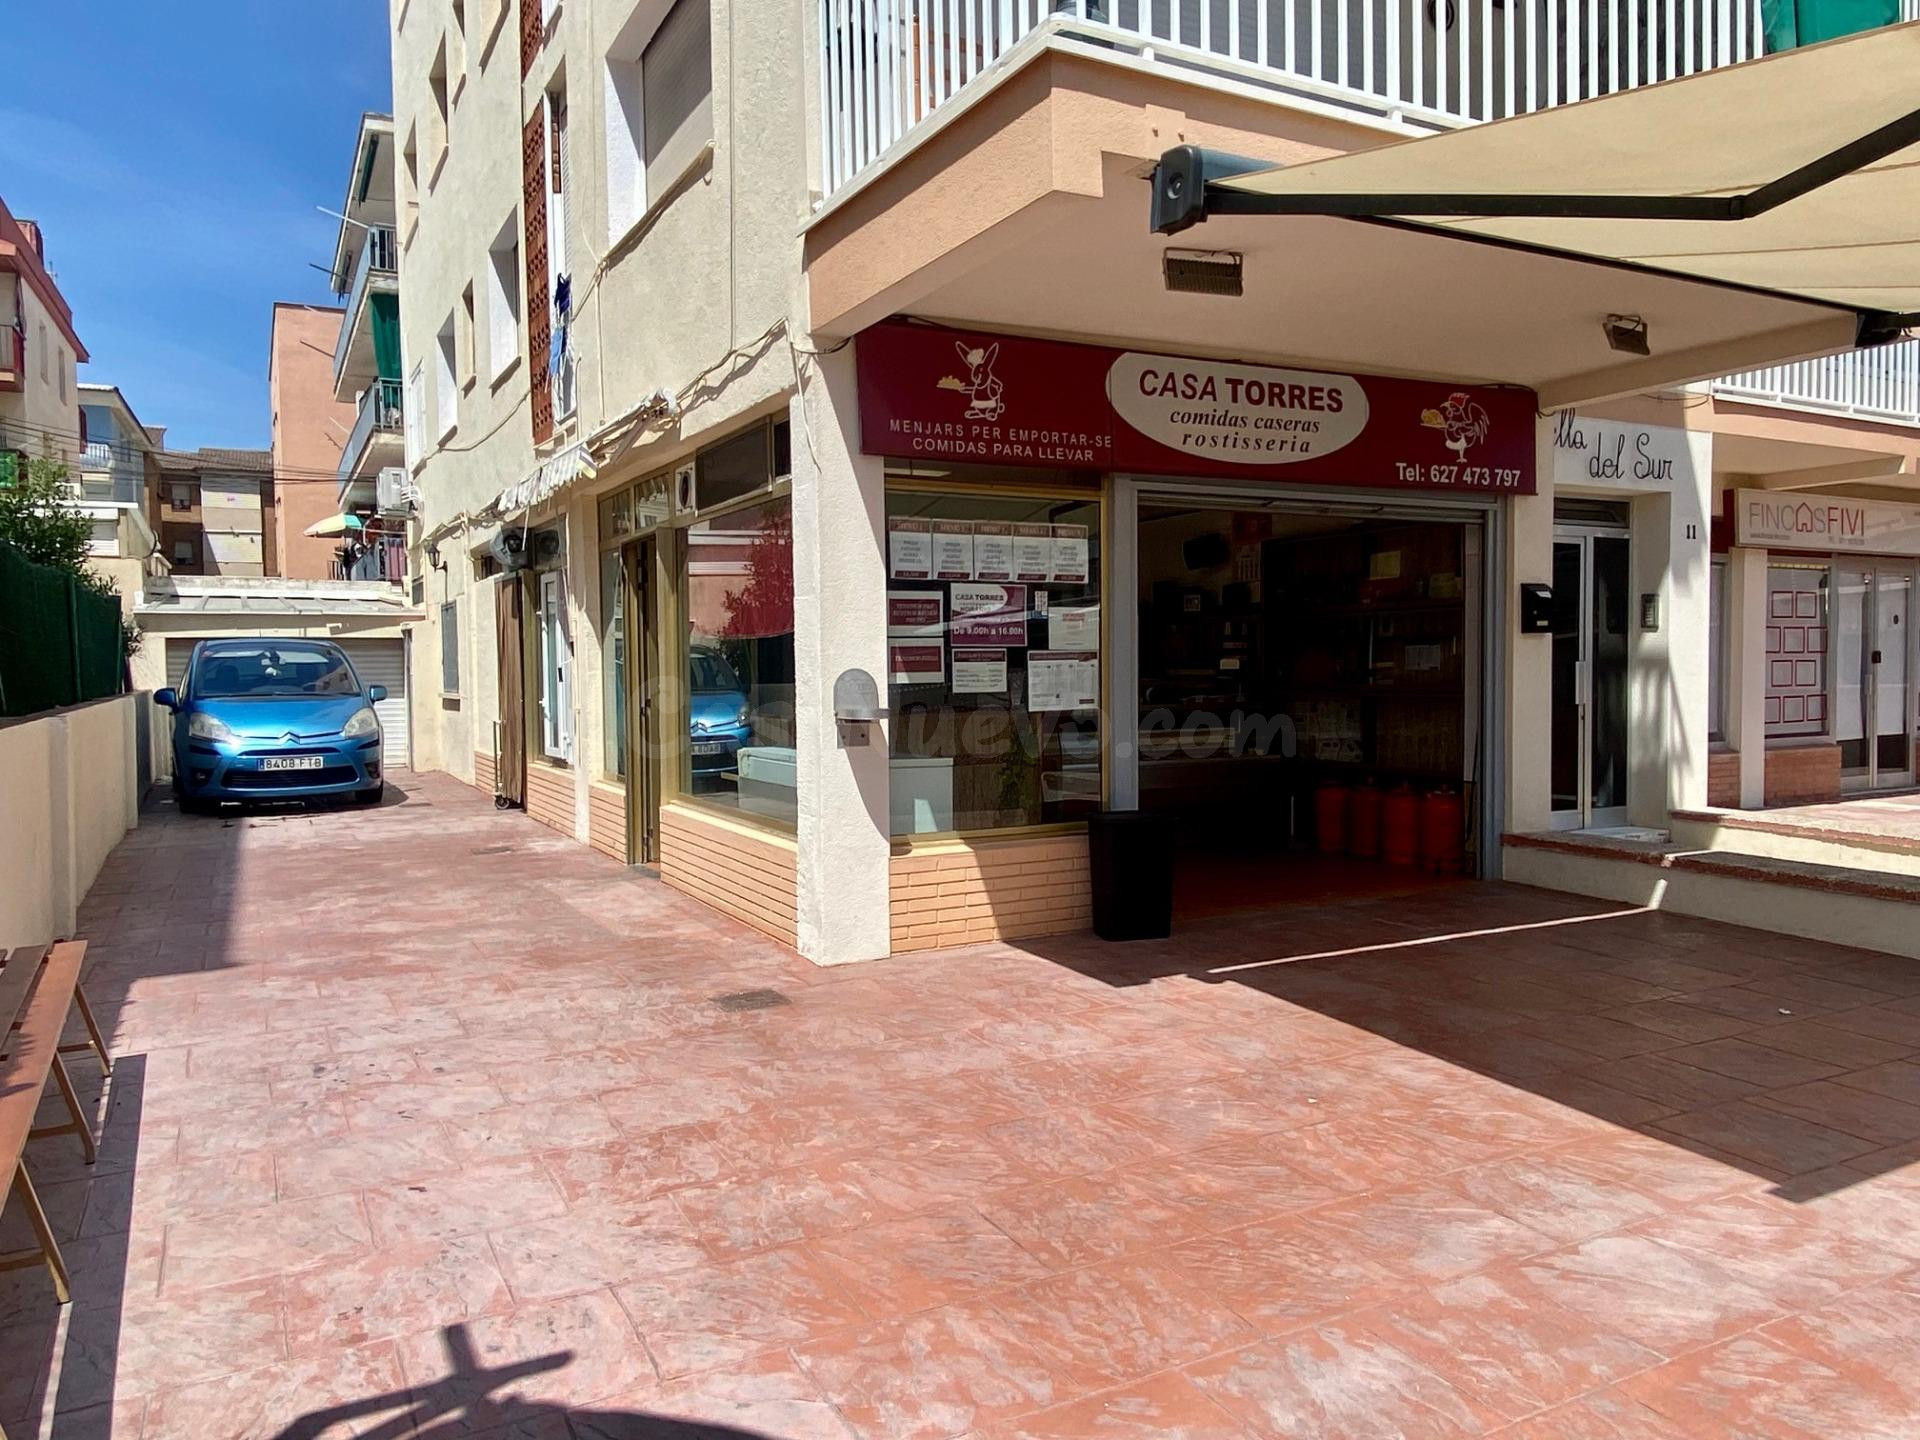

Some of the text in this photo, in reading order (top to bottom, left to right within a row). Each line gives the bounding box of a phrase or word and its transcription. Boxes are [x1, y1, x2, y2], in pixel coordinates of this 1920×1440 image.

[1139, 370, 1344, 413] CASA TORRES
[1170, 408, 1320, 433] comidas caseras
[889, 419, 1112, 448] MENJARS PER EMPORTAR-SE
[1182, 431, 1310, 453] rostisseria
[912, 438, 1094, 462] COMIDAS PARA LLEVAR
[1589, 431, 1673, 480] del Sur
[1395, 462, 1521, 487] Tel: 627 473 797
[1686, 524, 1697, 540] 11
[265, 758, 296, 769] 8408
